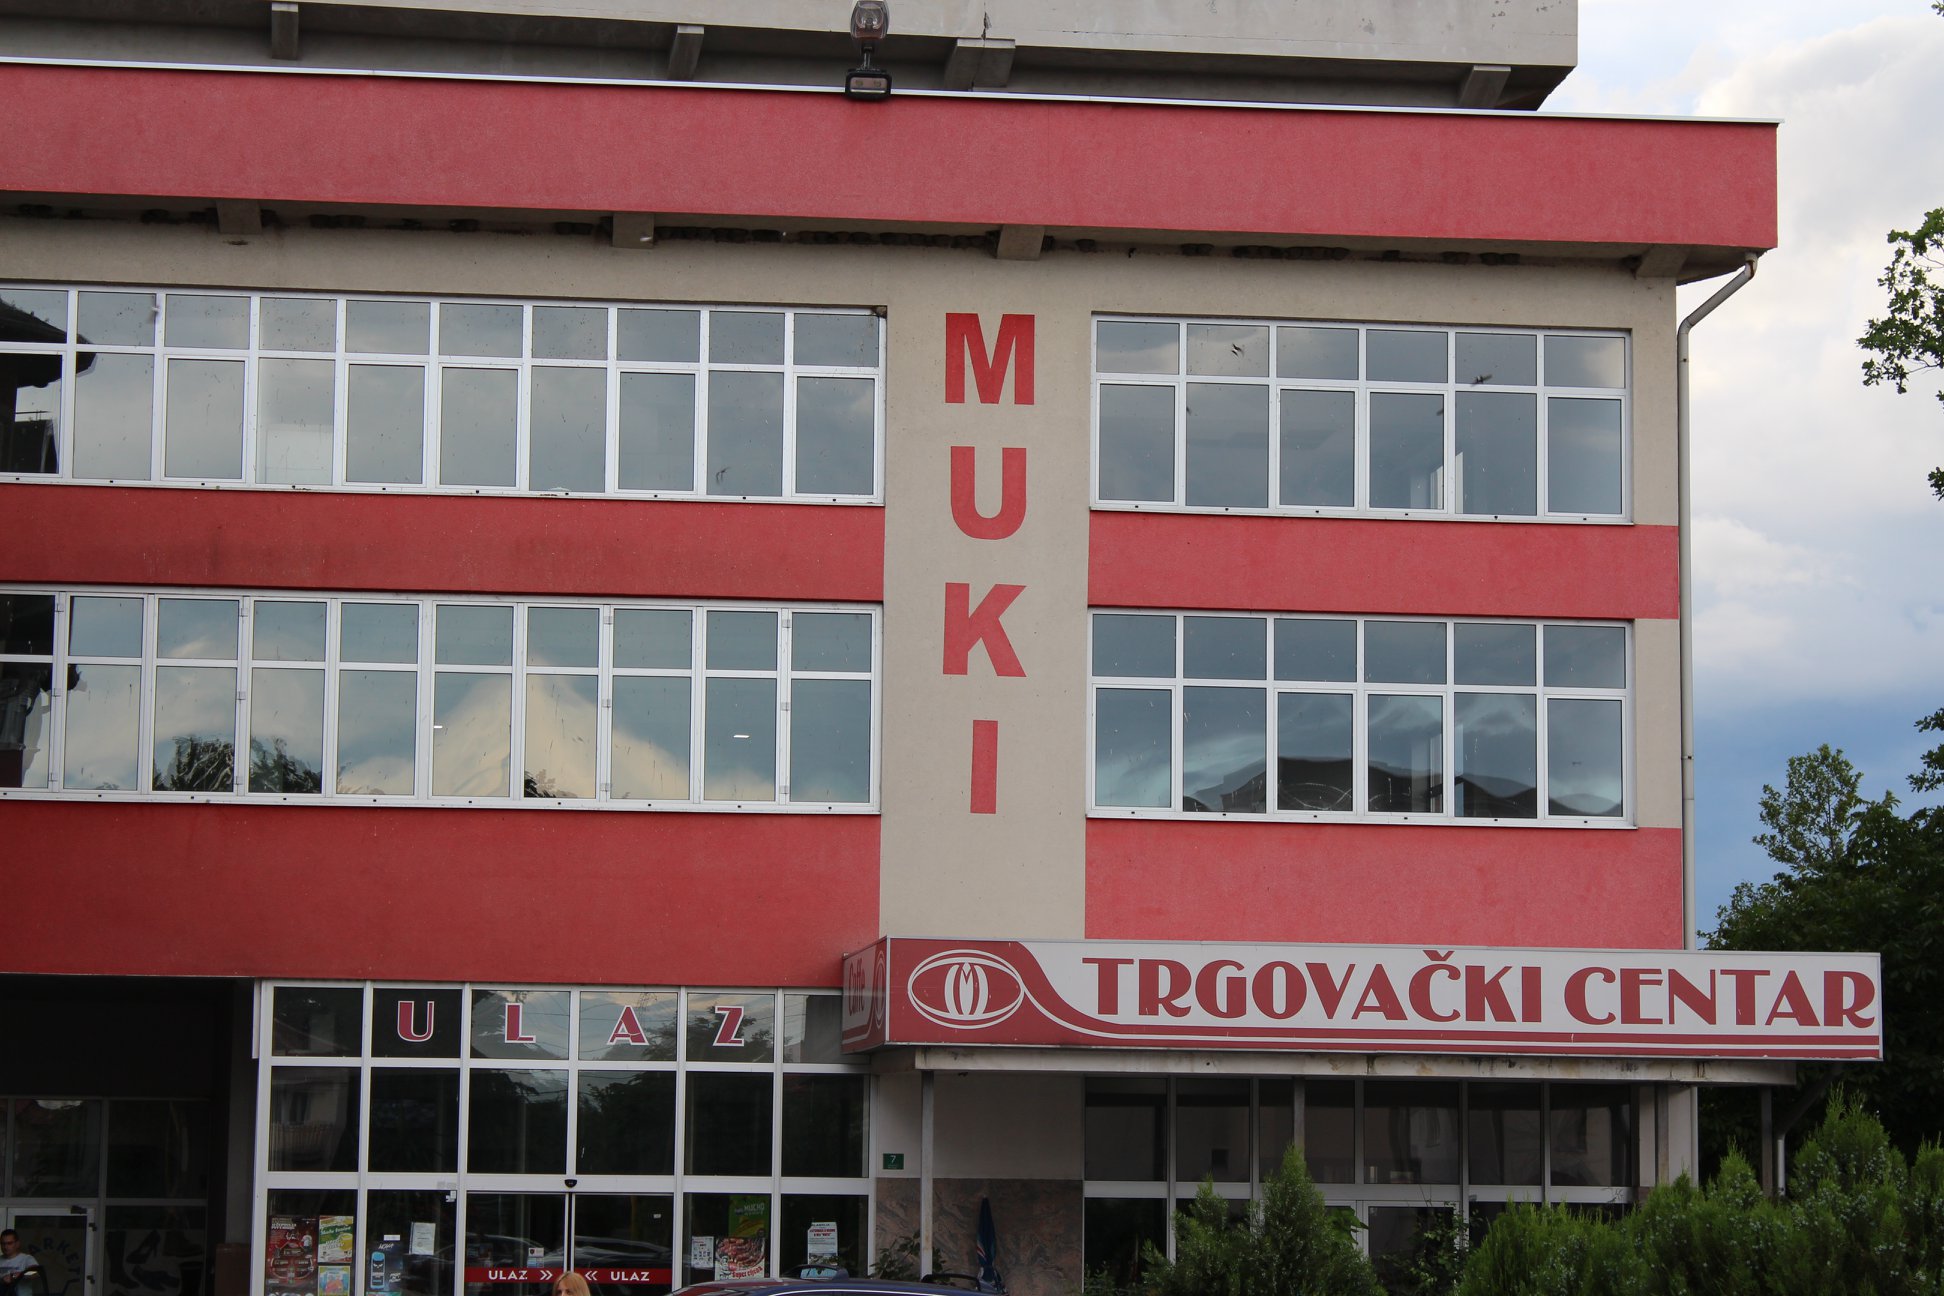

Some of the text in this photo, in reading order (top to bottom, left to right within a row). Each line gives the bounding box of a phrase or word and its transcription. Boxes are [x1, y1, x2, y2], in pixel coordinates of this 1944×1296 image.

[943, 313, 1035, 814] MUKI
[1082, 949, 1876, 1029] TRGOVAČKI CENTAR
[488, 1270, 528, 1280] ULAZ
[610, 1271, 650, 1281] ULAZ
